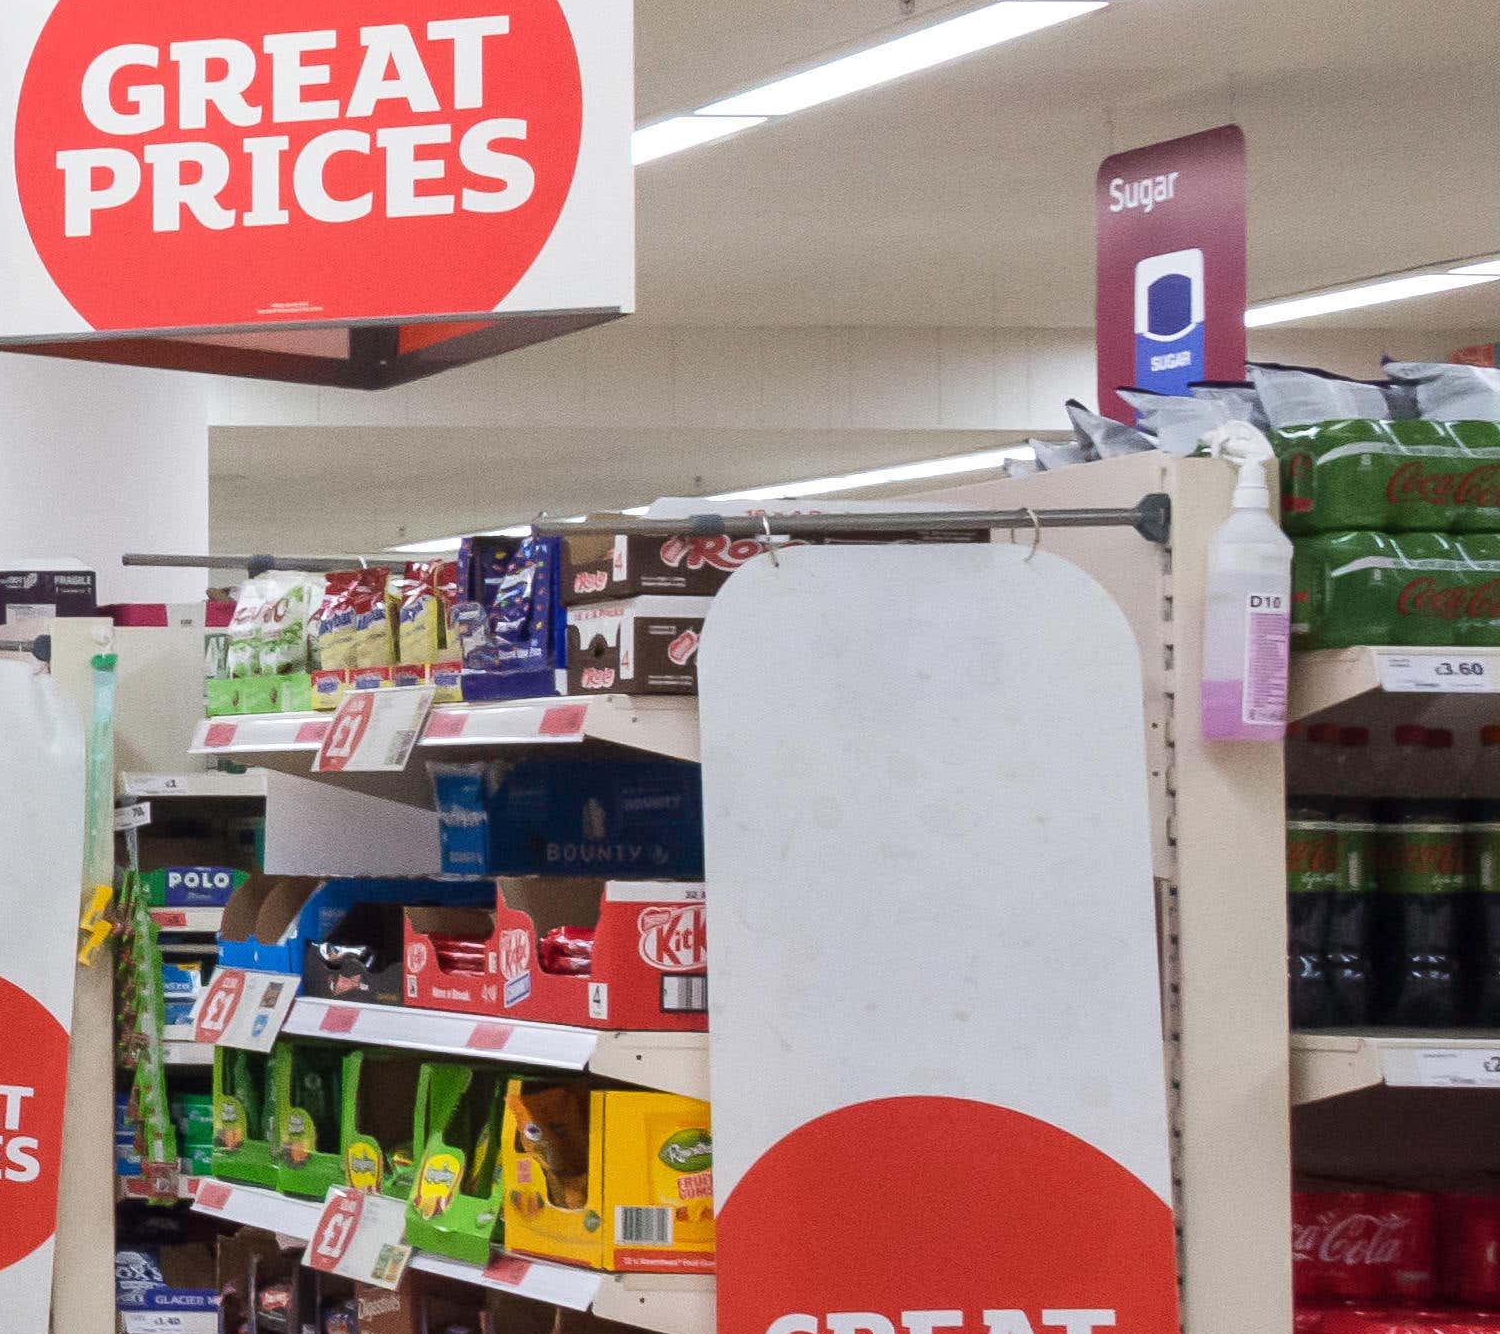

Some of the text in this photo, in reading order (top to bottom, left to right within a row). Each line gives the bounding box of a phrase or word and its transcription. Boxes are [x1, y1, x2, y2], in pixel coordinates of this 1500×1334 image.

[81, 15, 510, 135] GREAT
[56, 118, 536, 237] PRICES
[1108, 171, 1180, 215] Sugar
[1151, 349, 1192, 372] SUGAR
[1249, 594, 1282, 610] D10
[546, 842, 643, 862] BOUNTY
[168, 872, 230, 889] POLO
[155, 1295, 204, 1307] GLACIER
